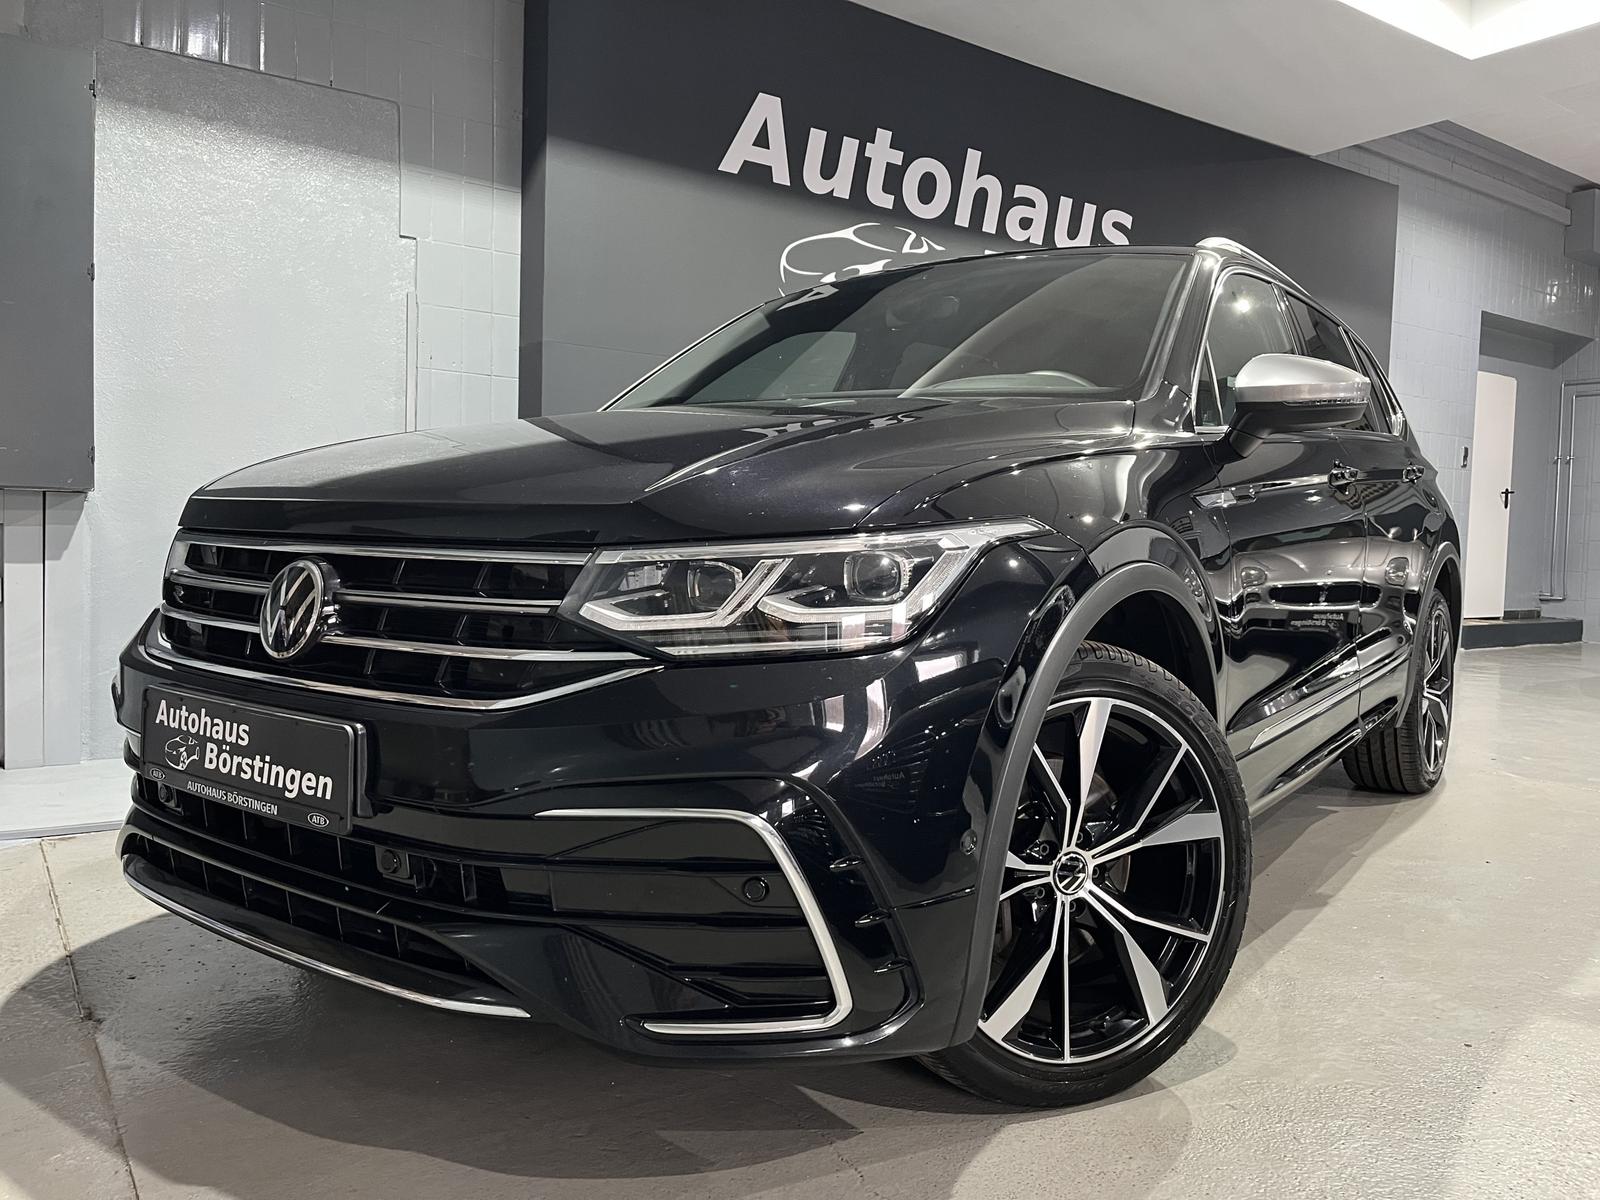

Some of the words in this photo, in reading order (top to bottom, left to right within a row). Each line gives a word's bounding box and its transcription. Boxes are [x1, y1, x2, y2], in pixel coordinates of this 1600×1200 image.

[717, 91, 1134, 248] Autohaus
[155, 699, 250, 746] Autohaus
[204, 741, 333, 800] Börstingen
[187, 780, 226, 801] AUTOHAUS
[227, 791, 278, 816] BÖRSTINGEN
